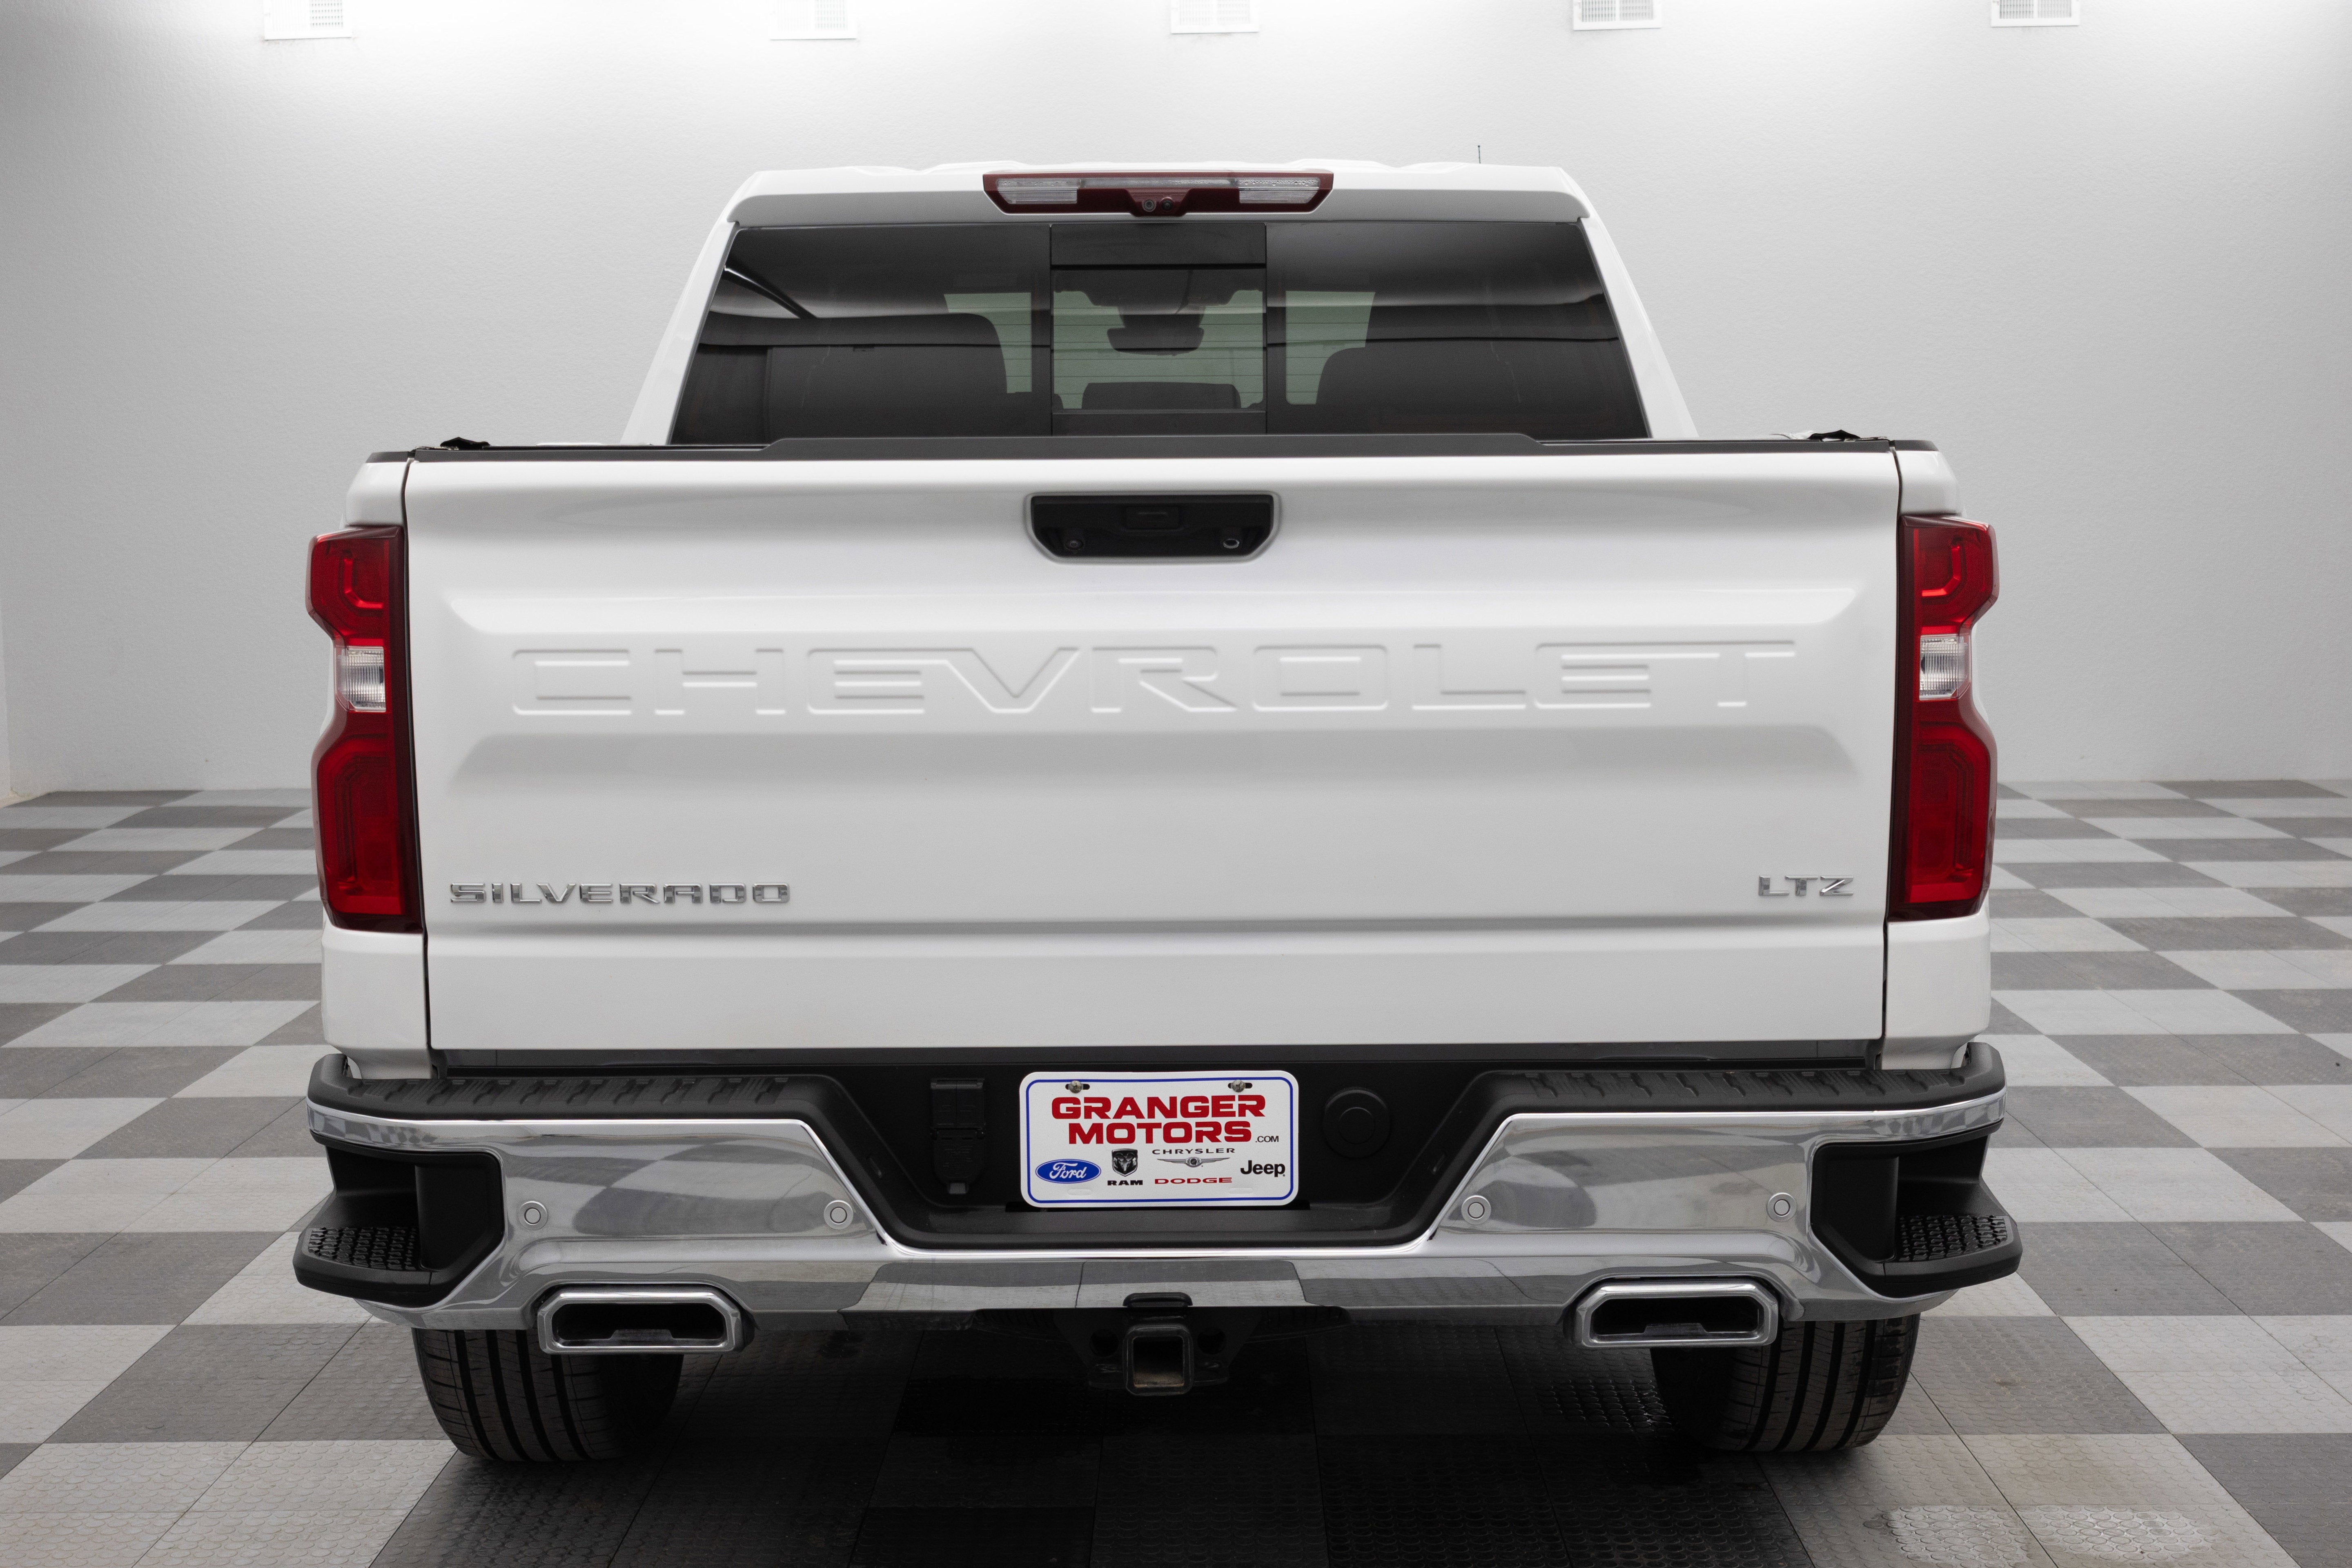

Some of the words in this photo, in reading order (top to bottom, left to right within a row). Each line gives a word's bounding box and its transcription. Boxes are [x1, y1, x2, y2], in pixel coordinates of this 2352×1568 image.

[512, 640, 1796, 715] CHEVROLET
[450, 882, 790, 903] SILVERADO
[1758, 875, 1853, 896] LTZ
[1051, 1095, 1265, 1119] GRANGER
[1069, 1121, 1252, 1144] MOTORS
[1049, 1162, 1087, 1179] Ford
[1240, 1160, 1285, 1177] Jeep
